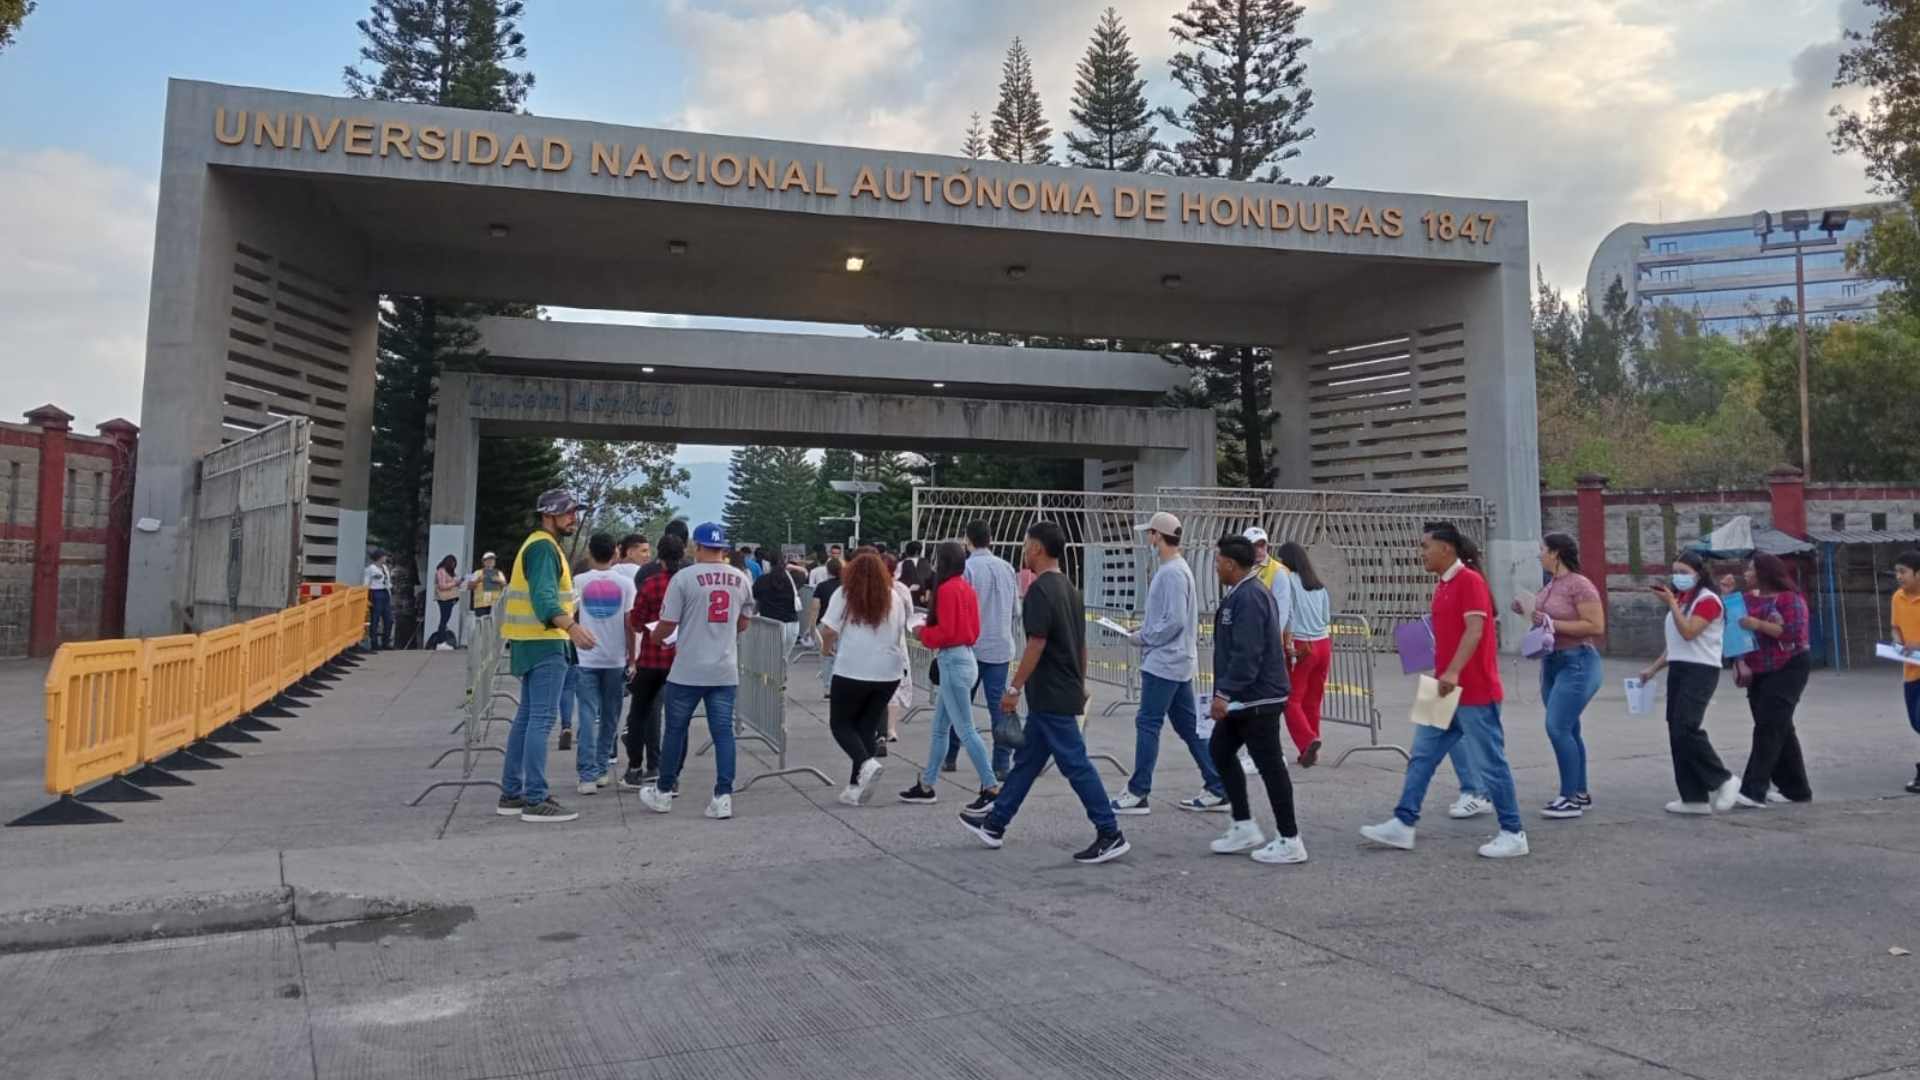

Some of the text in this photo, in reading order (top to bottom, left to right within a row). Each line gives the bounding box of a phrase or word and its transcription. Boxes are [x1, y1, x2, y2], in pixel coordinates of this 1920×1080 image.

[214, 105, 1497, 245] UNIVERSIDAD NACIONAL AUTÓNOMA DE HONDURAS 1847
[696, 572, 742, 588] DOZIER
[707, 590, 730, 623] 2
